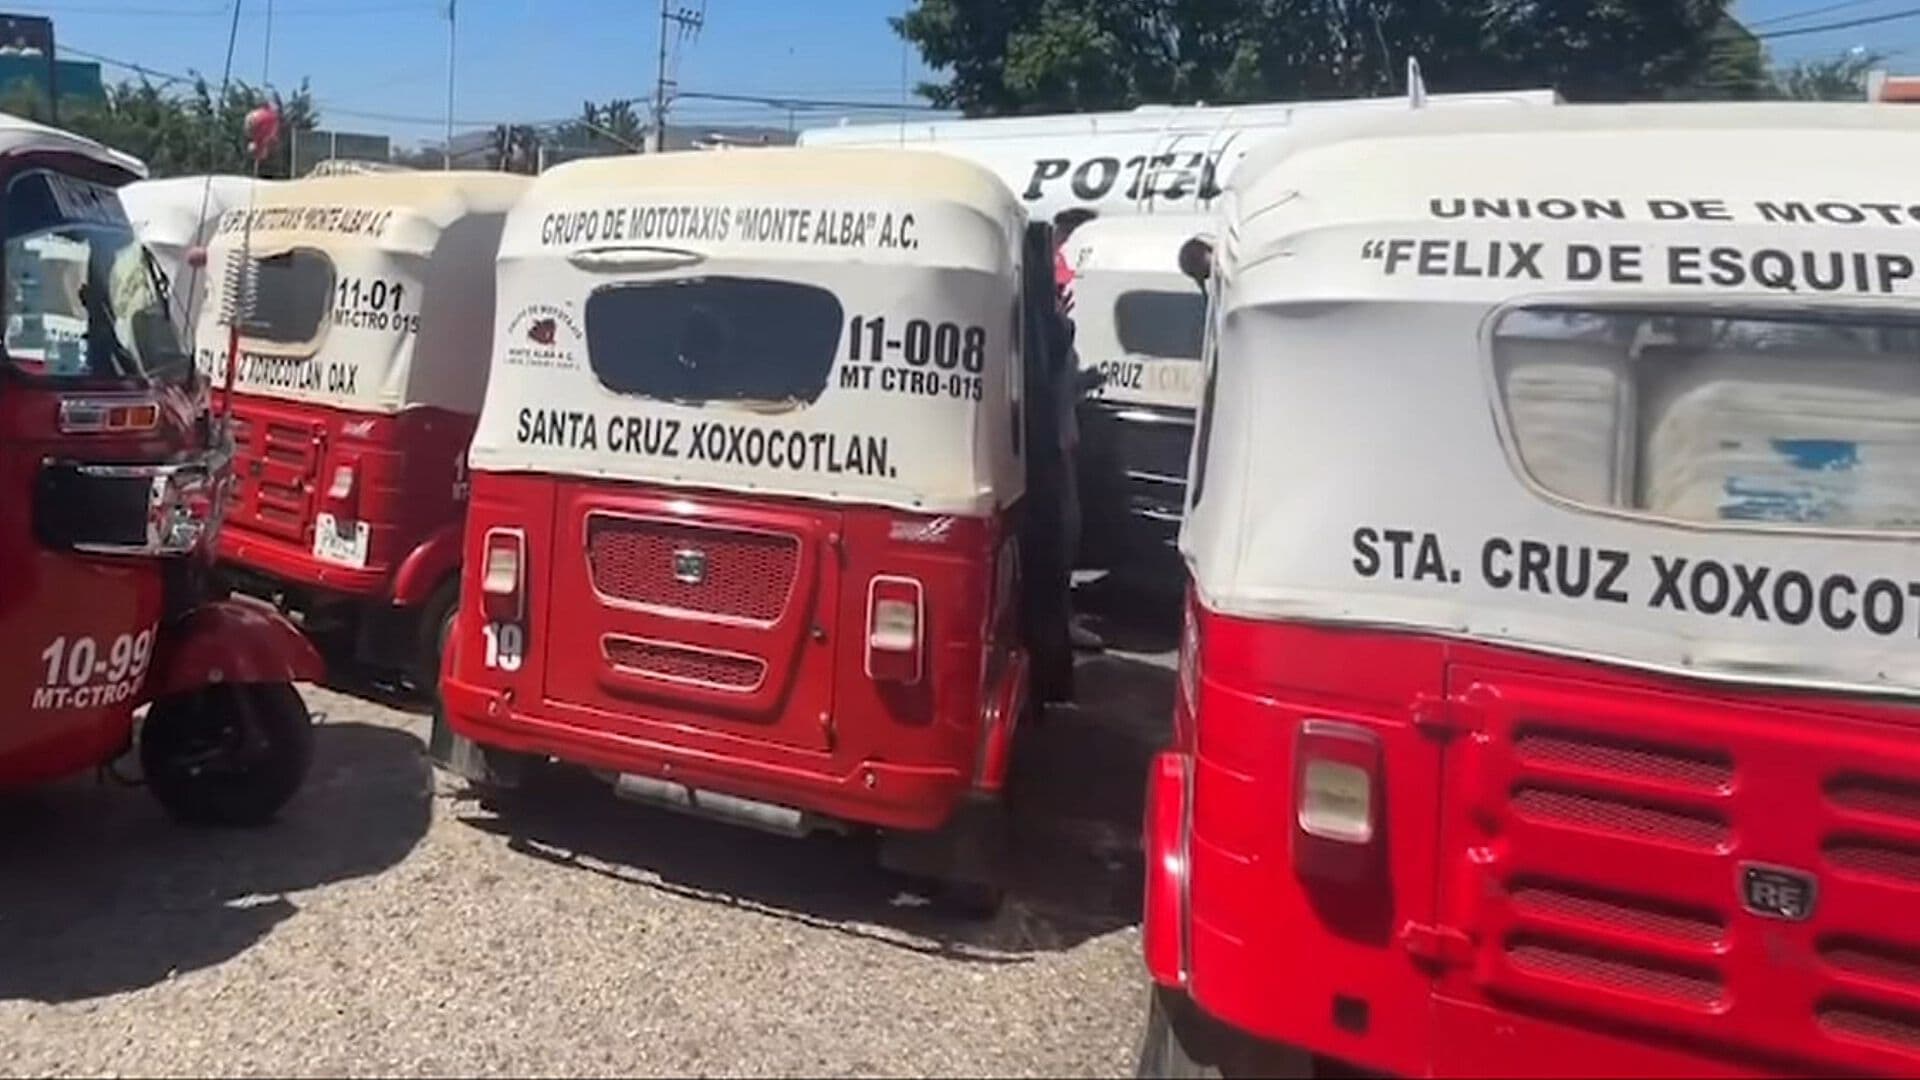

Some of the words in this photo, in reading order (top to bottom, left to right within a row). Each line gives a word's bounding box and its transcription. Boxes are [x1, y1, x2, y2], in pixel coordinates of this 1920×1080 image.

[542, 210, 598, 245] GRUPO
[602, 209, 627, 240] DE
[628, 206, 731, 241] MOTOTAXIS
[878, 212, 918, 249] A.C.
[1430, 198, 1625, 220] UNION
[1648, 200, 1734, 221] DE
[1566, 244, 1644, 283] DE
[1666, 247, 1914, 293] ESQUIP
[849, 315, 986, 374] 11-008
[328, 361, 359, 395] OAX
[839, 365, 873, 390] MT
[881, 366, 983, 402] CTRO-015
[516, 407, 597, 451] SANTA
[607, 415, 681, 457] CRUZ
[687, 422, 897, 478] XOXOCOTLAN.
[1352, 527, 1461, 584] STA.
[1481, 537, 1630, 603] CRUZ
[482, 623, 523, 672] 19
